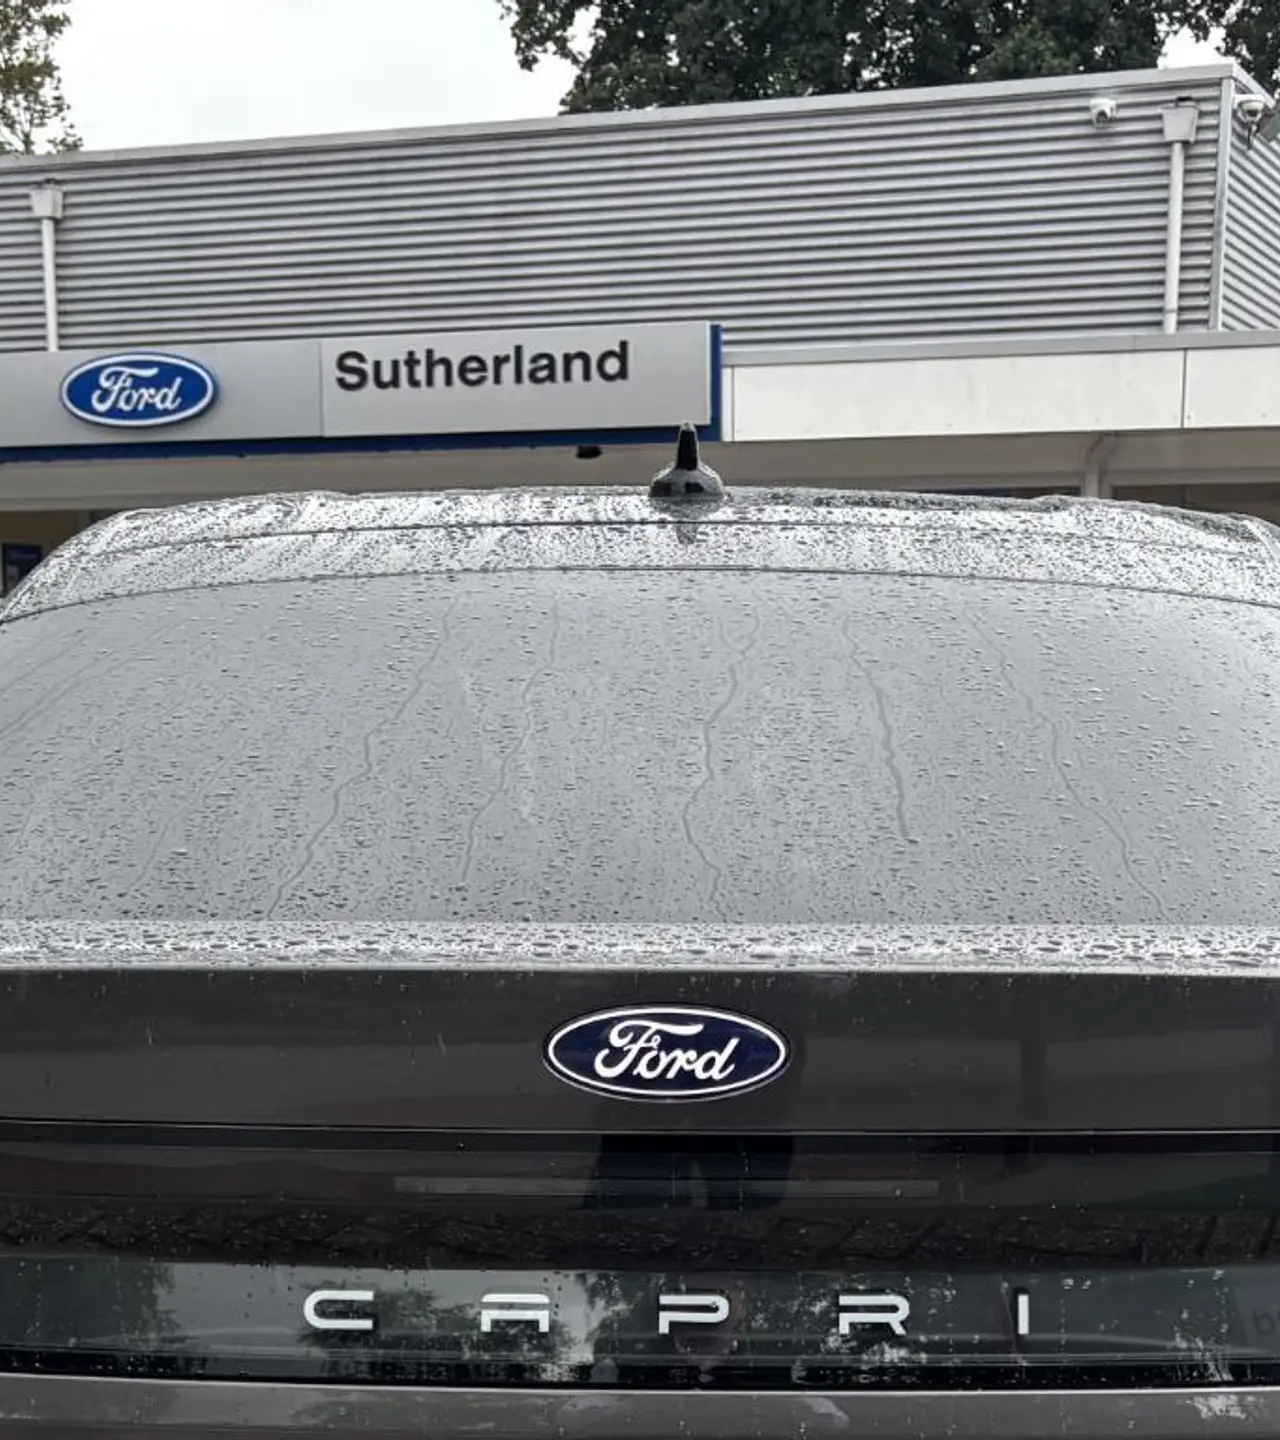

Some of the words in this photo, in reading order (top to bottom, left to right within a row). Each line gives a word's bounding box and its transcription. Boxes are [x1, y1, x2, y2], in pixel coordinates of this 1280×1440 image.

[91, 366, 183, 412] Ford
[335, 339, 629, 391] Sutherland
[593, 1018, 740, 1081] Ford
[302, 1289, 1030, 1336] CAPRI
